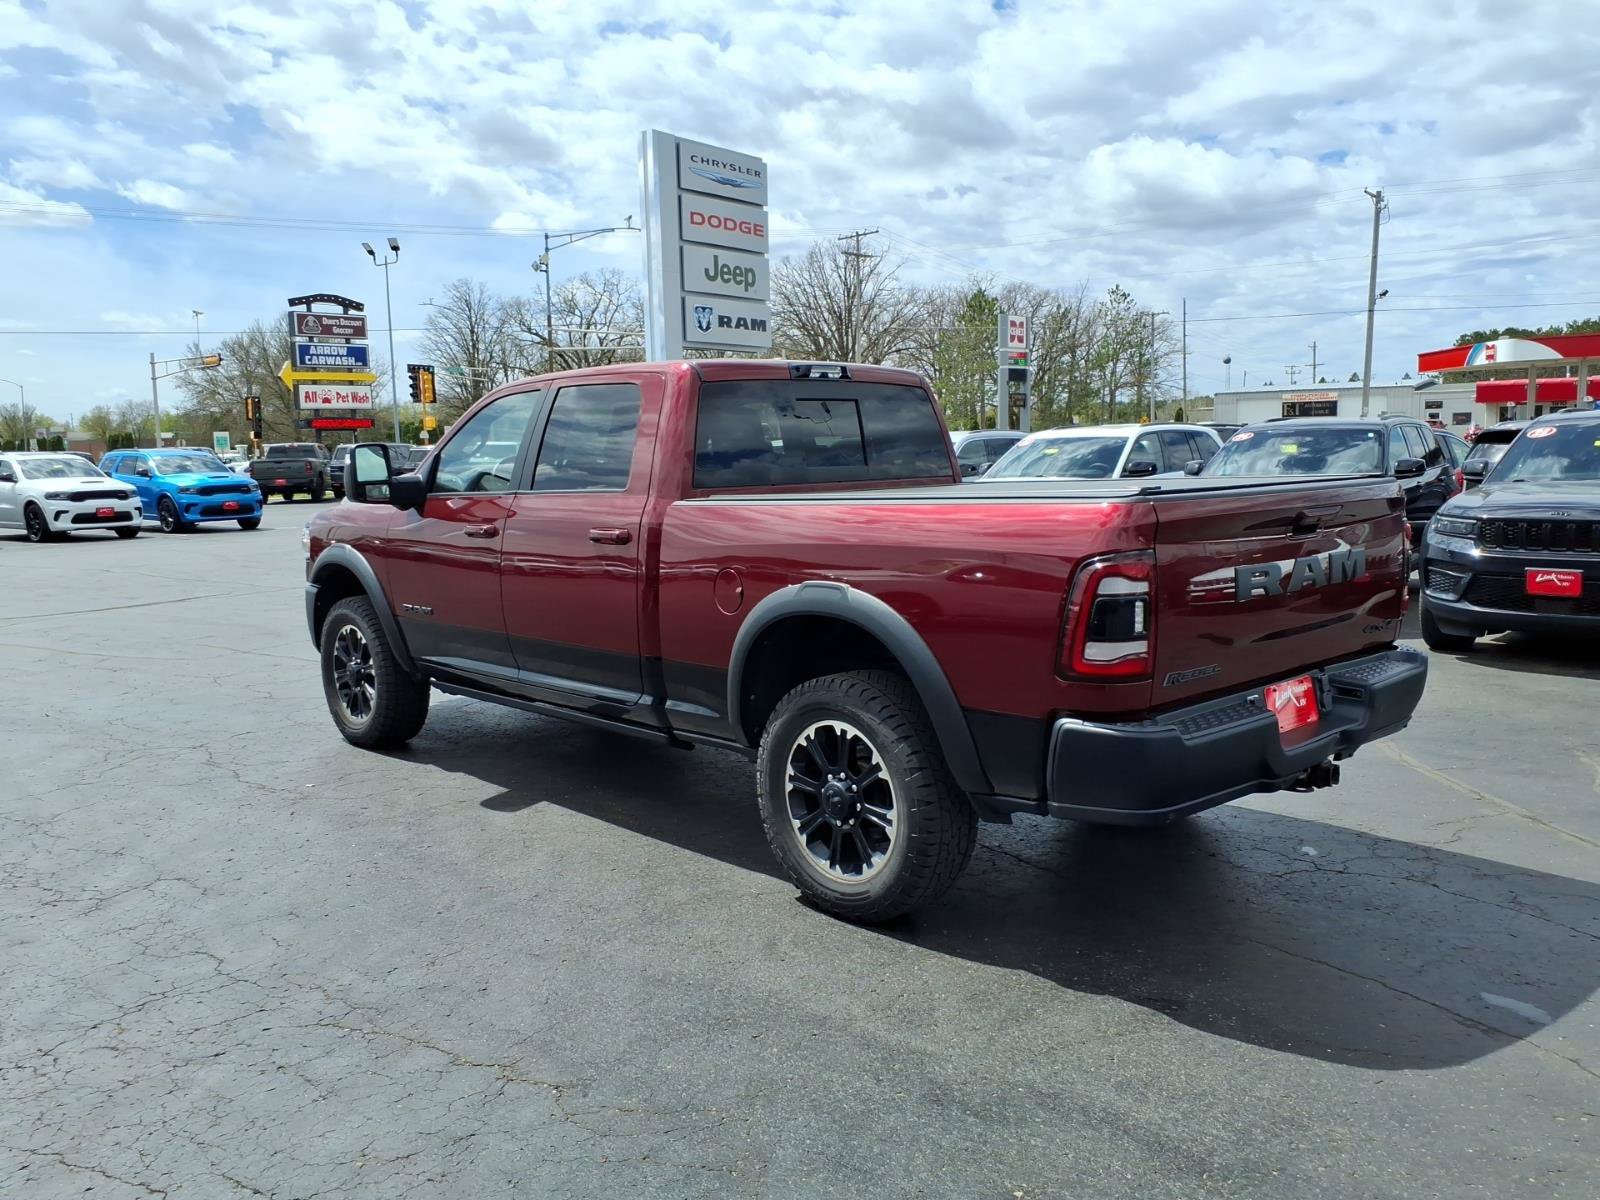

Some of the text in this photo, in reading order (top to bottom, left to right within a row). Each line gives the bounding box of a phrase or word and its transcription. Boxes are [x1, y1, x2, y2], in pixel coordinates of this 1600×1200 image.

[690, 154, 761, 178] CHRYSLER
[690, 211, 765, 237] DODGE
[704, 254, 756, 292] Jeep
[718, 314, 767, 332] RAM
[309, 346, 347, 356] ARROW
[304, 390, 370, 405] All Pet Wash
[1234, 547, 1366, 602] RAM
